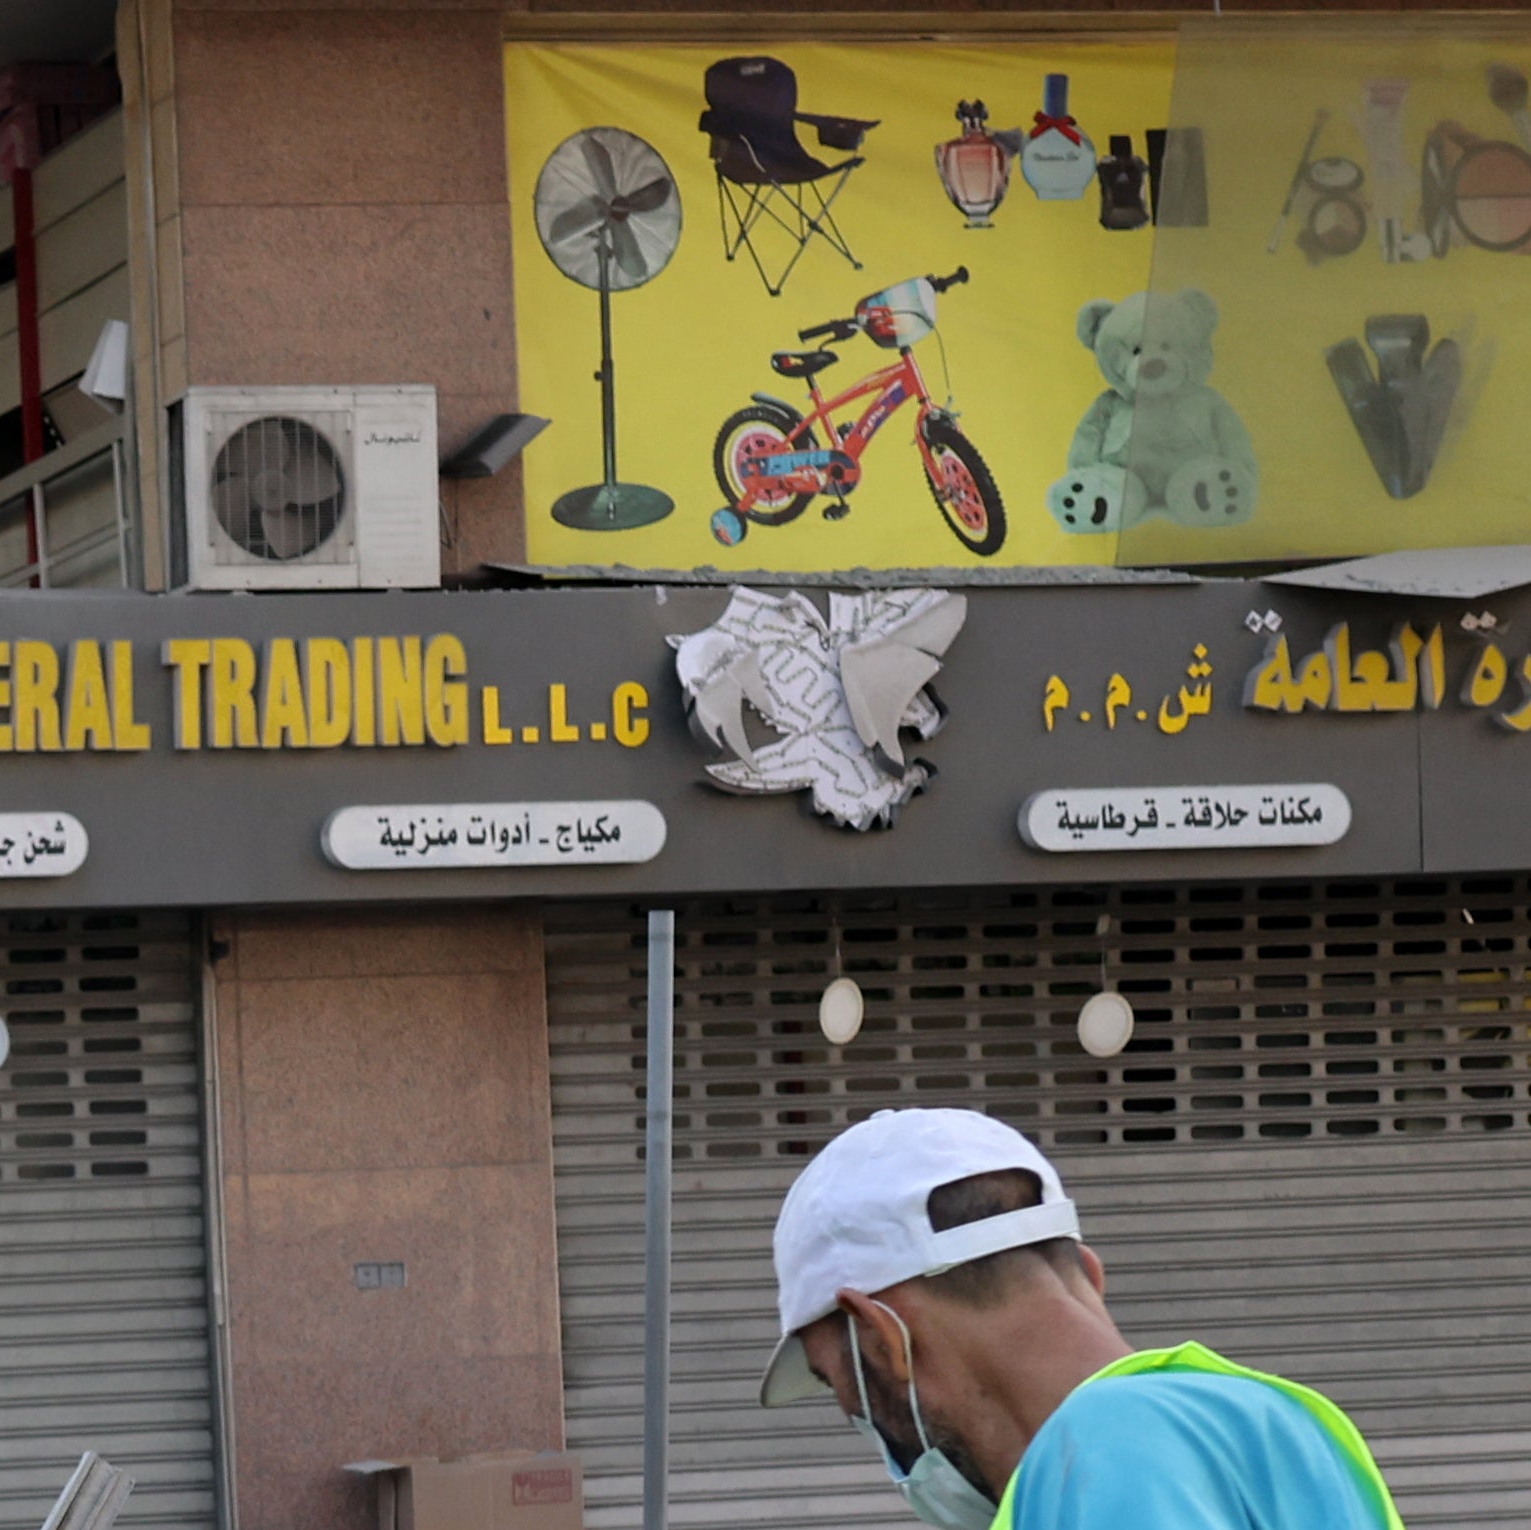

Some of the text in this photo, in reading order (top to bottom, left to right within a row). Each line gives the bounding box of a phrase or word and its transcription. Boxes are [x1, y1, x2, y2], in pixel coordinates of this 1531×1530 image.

[1243, 609, 1445, 714] العامة
[165, 633, 470, 750] TRADING
[482, 680, 651, 748] L.L.C
[1055, 798, 1159, 840] قرطاسية
[1181, 796, 1249, 830] حلاقة
[1258, 795, 1323, 827] مكنات
[22, 819, 68, 865] شحن
[377, 816, 459, 857] منزلية
[466, 813, 531, 853] أدوات
[555, 814, 621, 853] مكياج
